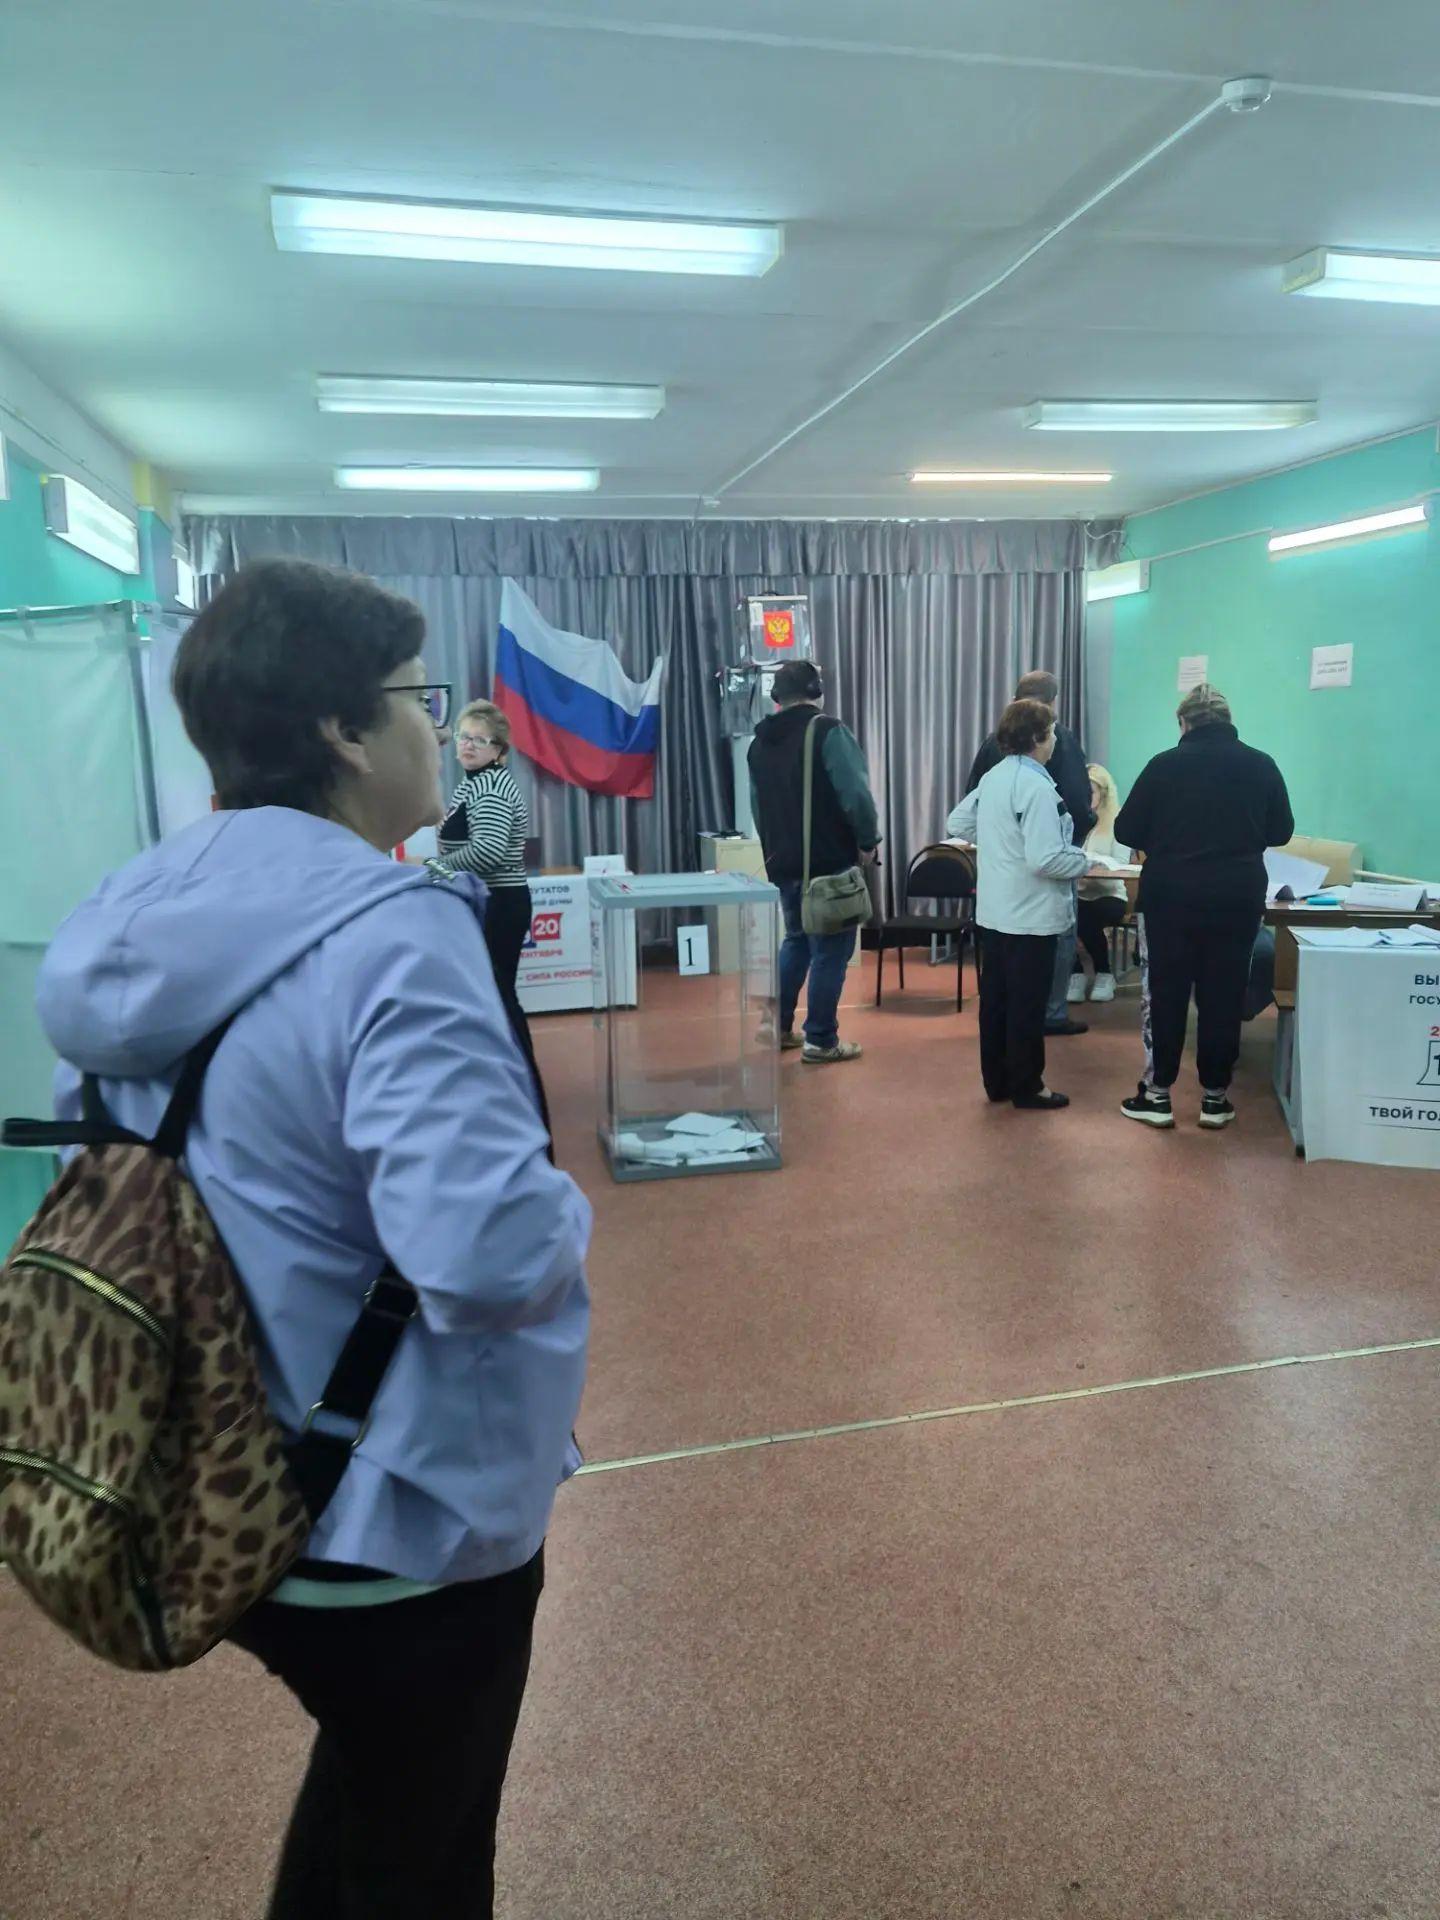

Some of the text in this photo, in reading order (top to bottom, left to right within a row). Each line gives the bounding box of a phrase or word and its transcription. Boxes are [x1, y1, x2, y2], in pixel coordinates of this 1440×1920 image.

[534, 919, 559, 936] 20
[685, 937, 696, 967] 1
[1414, 974, 1440, 985] ВЫ
[1368, 1106, 1440, 1121] ТВОЙ ГО
